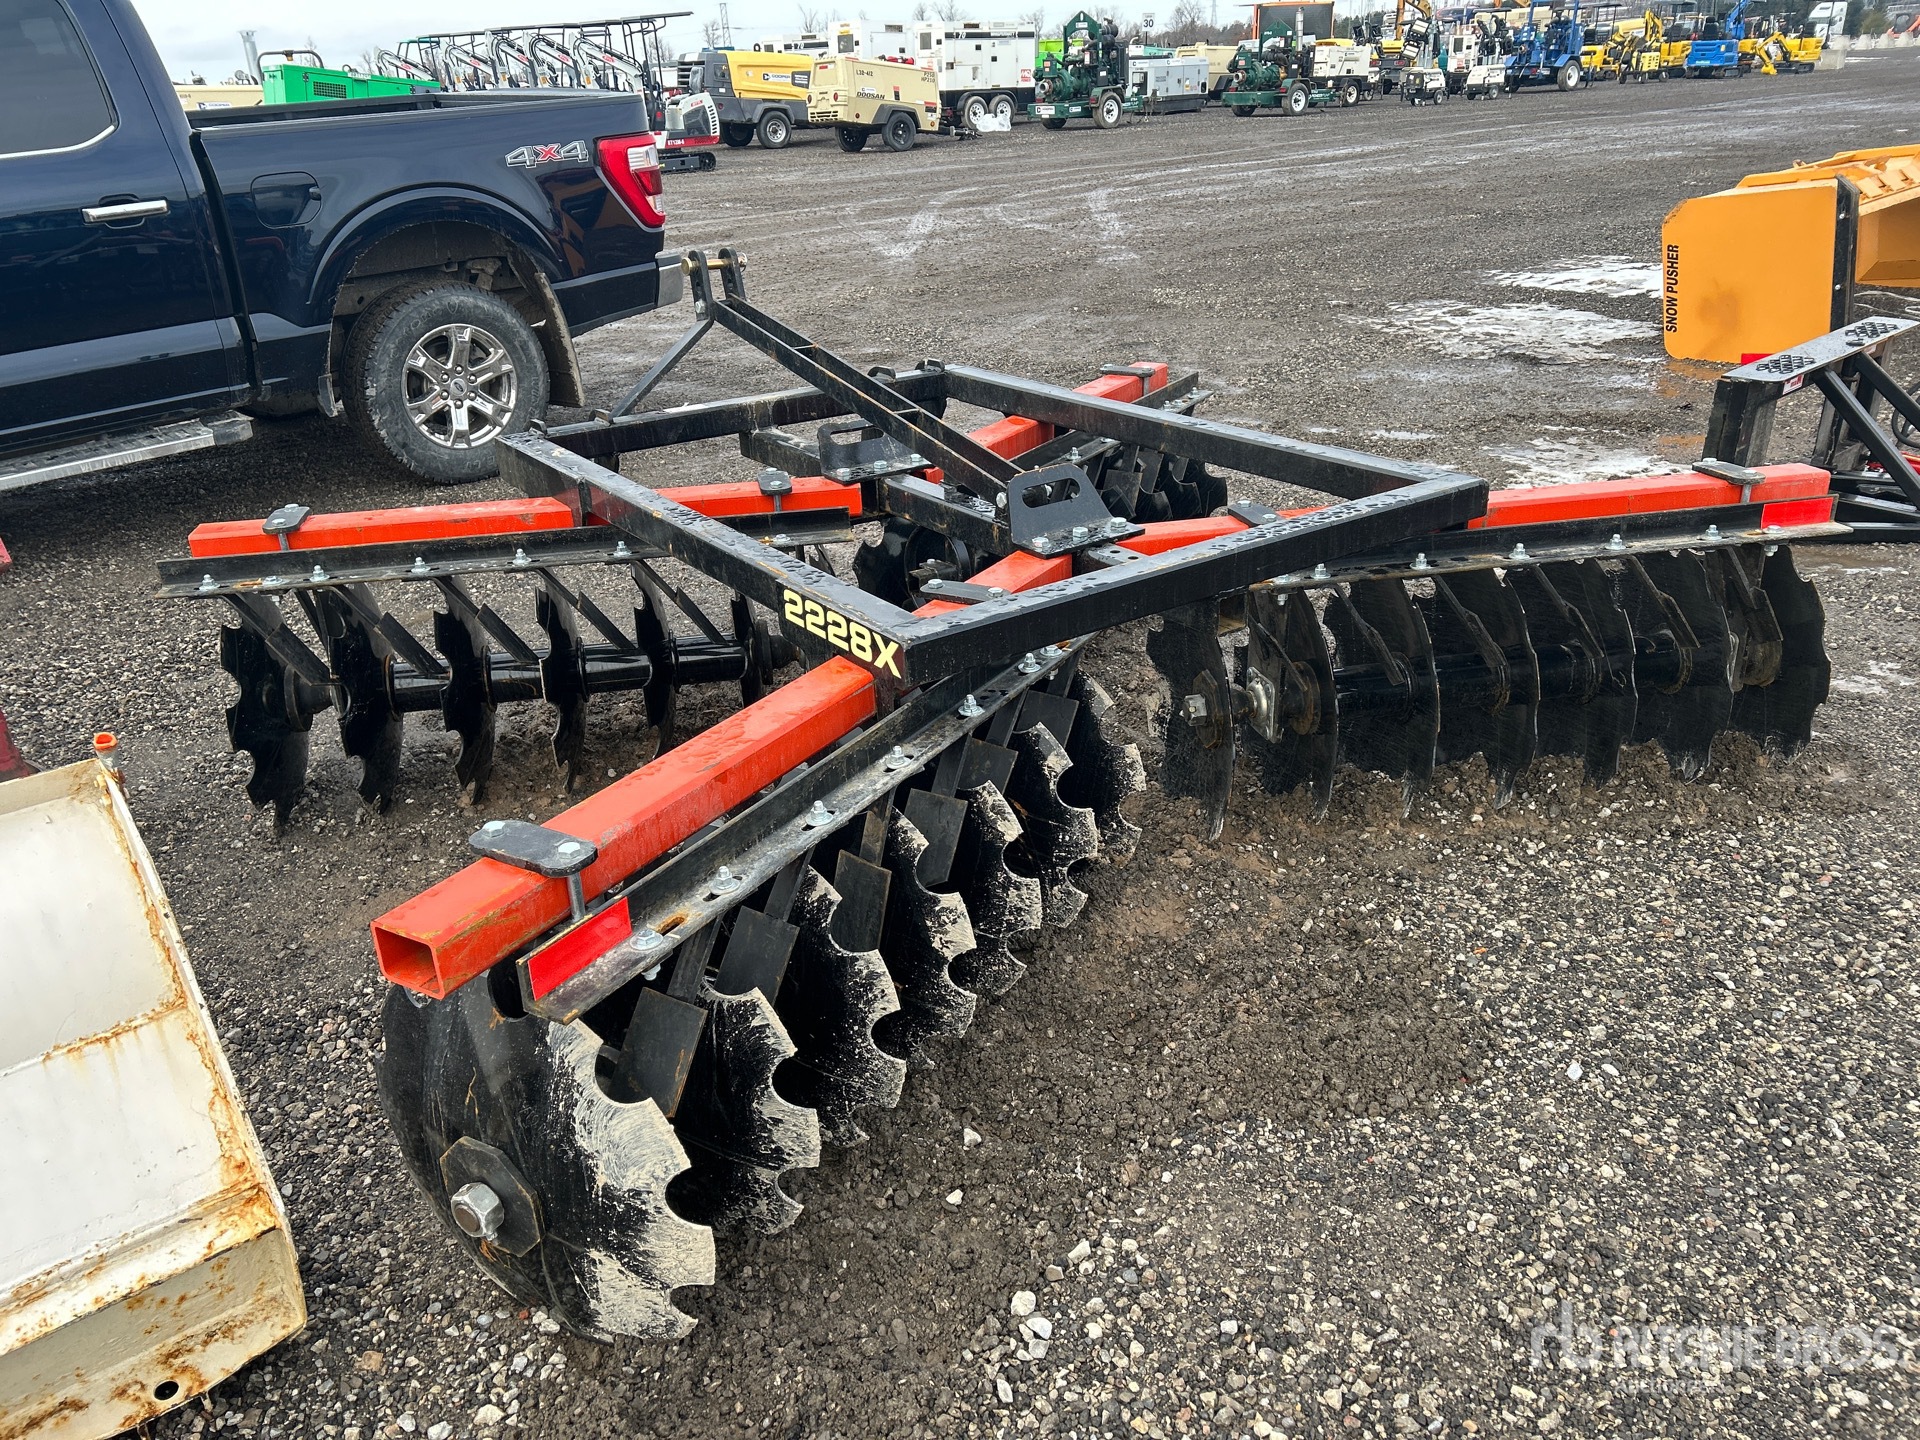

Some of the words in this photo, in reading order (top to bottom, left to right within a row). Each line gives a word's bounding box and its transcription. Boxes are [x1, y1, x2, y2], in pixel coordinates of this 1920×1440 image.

[1143, 18, 1154, 28] 30
[856, 91, 886, 100] DOOSAN
[1666, 244, 1680, 294] PUSHER
[1665, 296, 1679, 333] SNOW
[783, 589, 902, 680] 2228X
